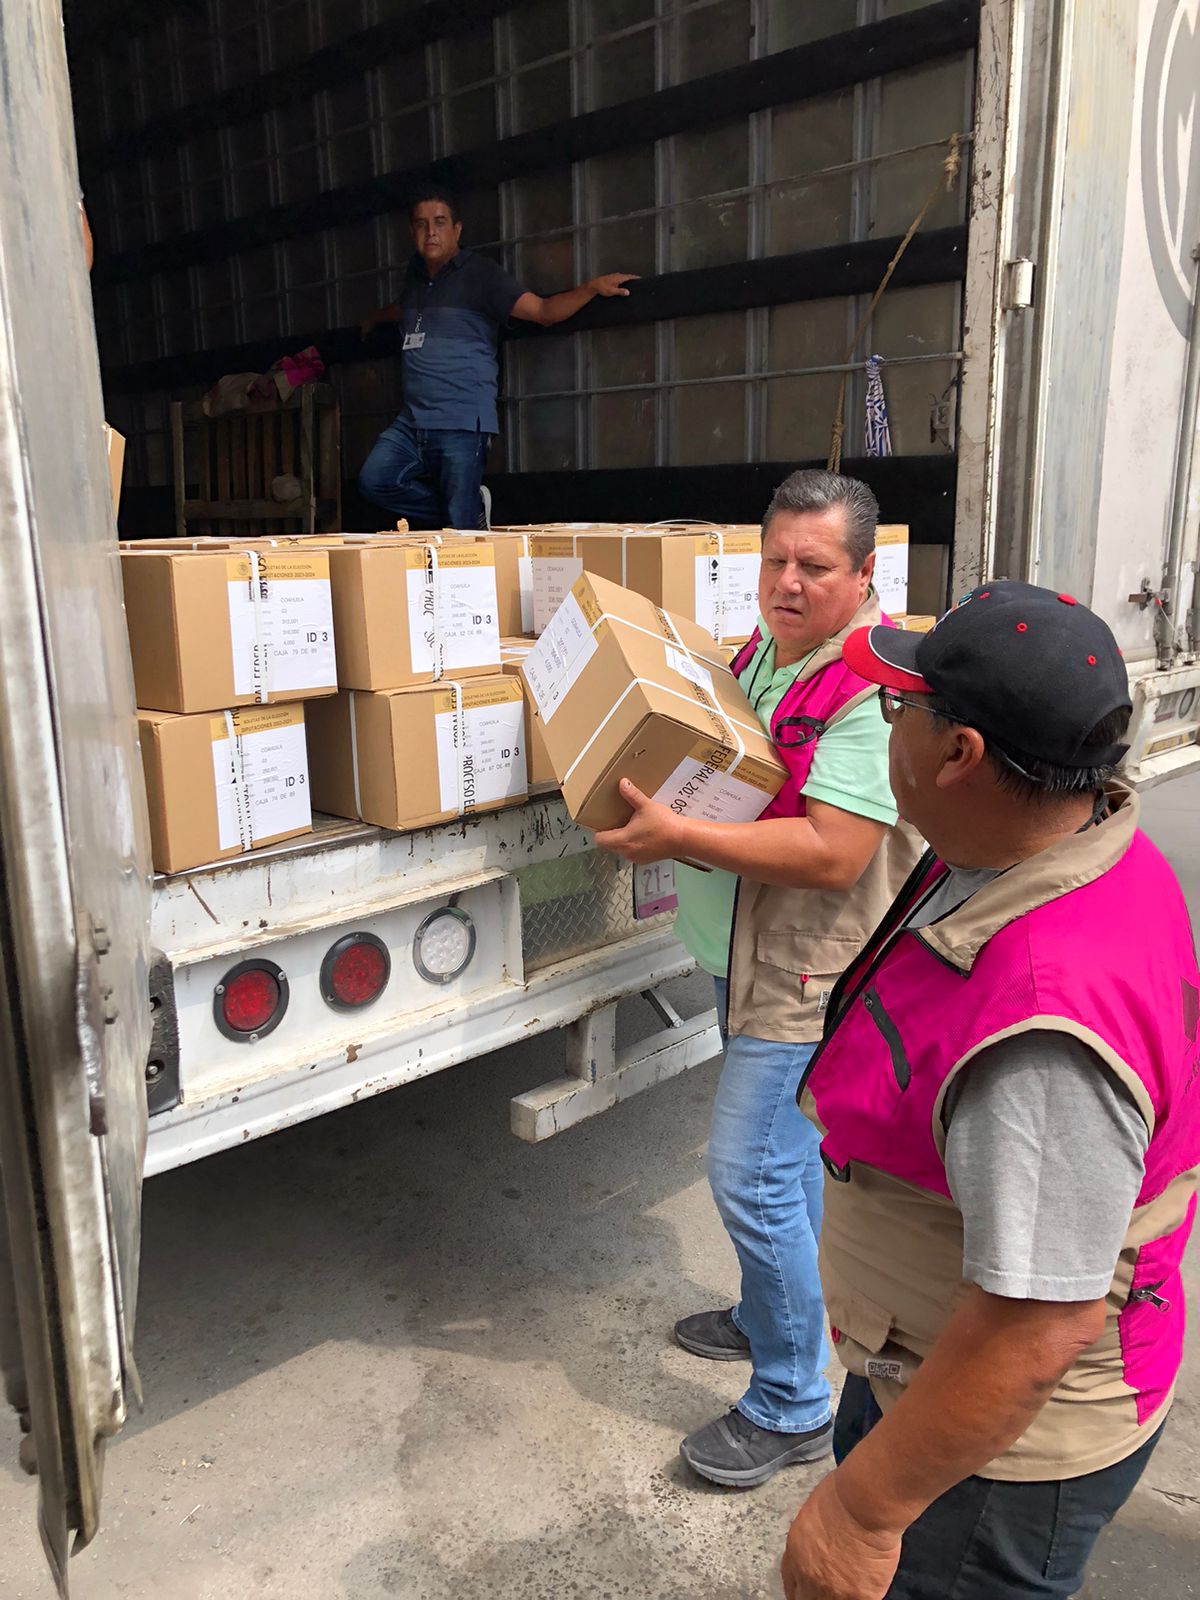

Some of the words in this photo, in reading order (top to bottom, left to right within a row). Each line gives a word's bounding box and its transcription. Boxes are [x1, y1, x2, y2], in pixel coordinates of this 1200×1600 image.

[473, 615, 482, 625] ID
[486, 615, 492, 624] 3
[306, 632, 317, 643] ID
[322, 632, 328, 642] 3
[501, 749, 511, 759] ID
[514, 747, 520, 756] 3
[692, 745, 731, 784] FEDERAL
[286, 777, 296, 787] ID
[299, 774, 305, 784] 3
